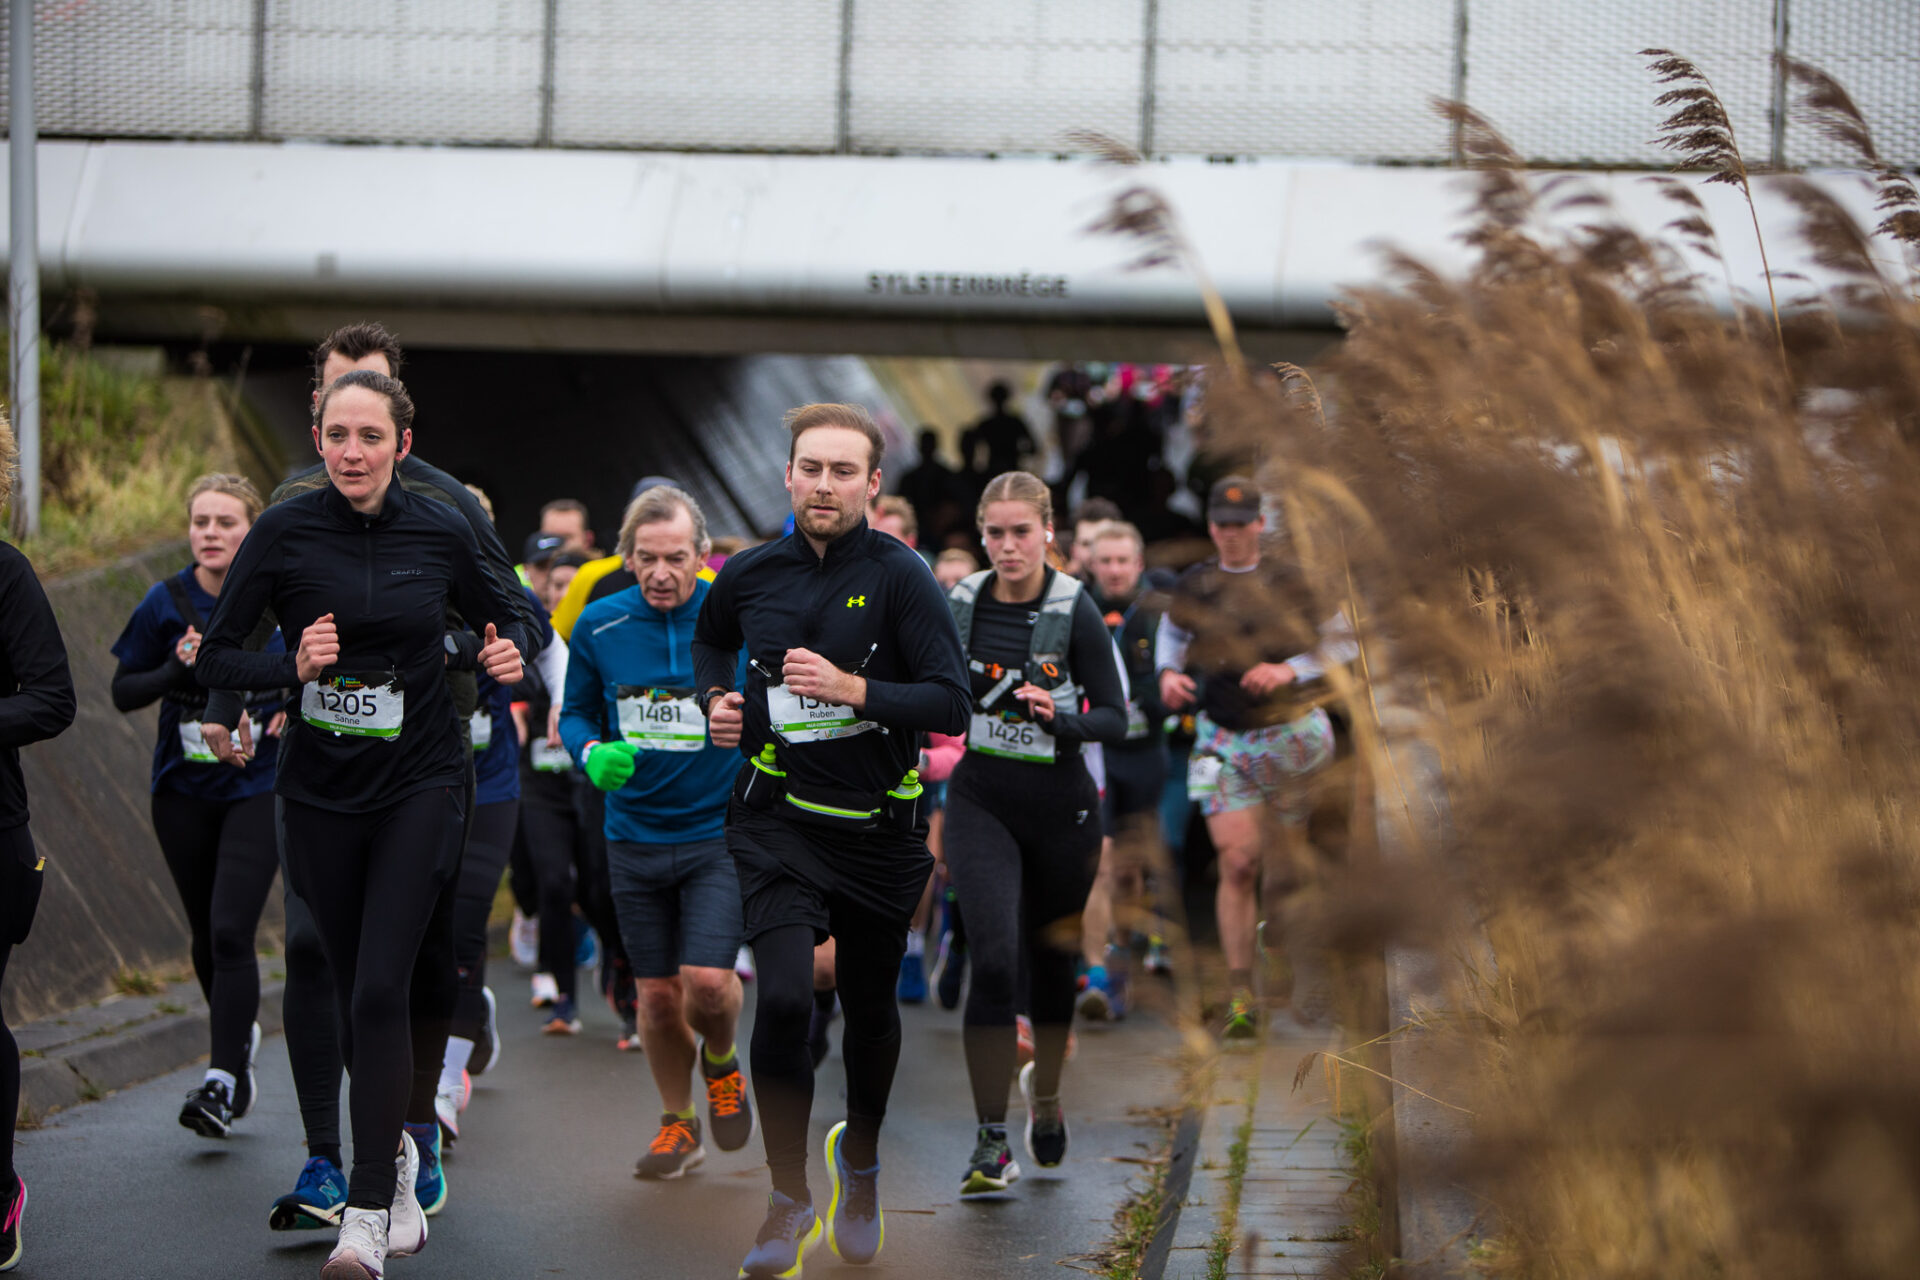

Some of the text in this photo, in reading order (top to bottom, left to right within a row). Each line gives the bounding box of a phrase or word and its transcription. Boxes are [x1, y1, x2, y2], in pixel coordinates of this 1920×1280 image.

[317, 691, 377, 716] 1205
[636, 703, 681, 723] 1481
[809, 710, 836, 719] Ruben
[334, 714, 361, 725] Sanne
[987, 720, 1034, 746] 1426
[318, 1178, 341, 1205] N
